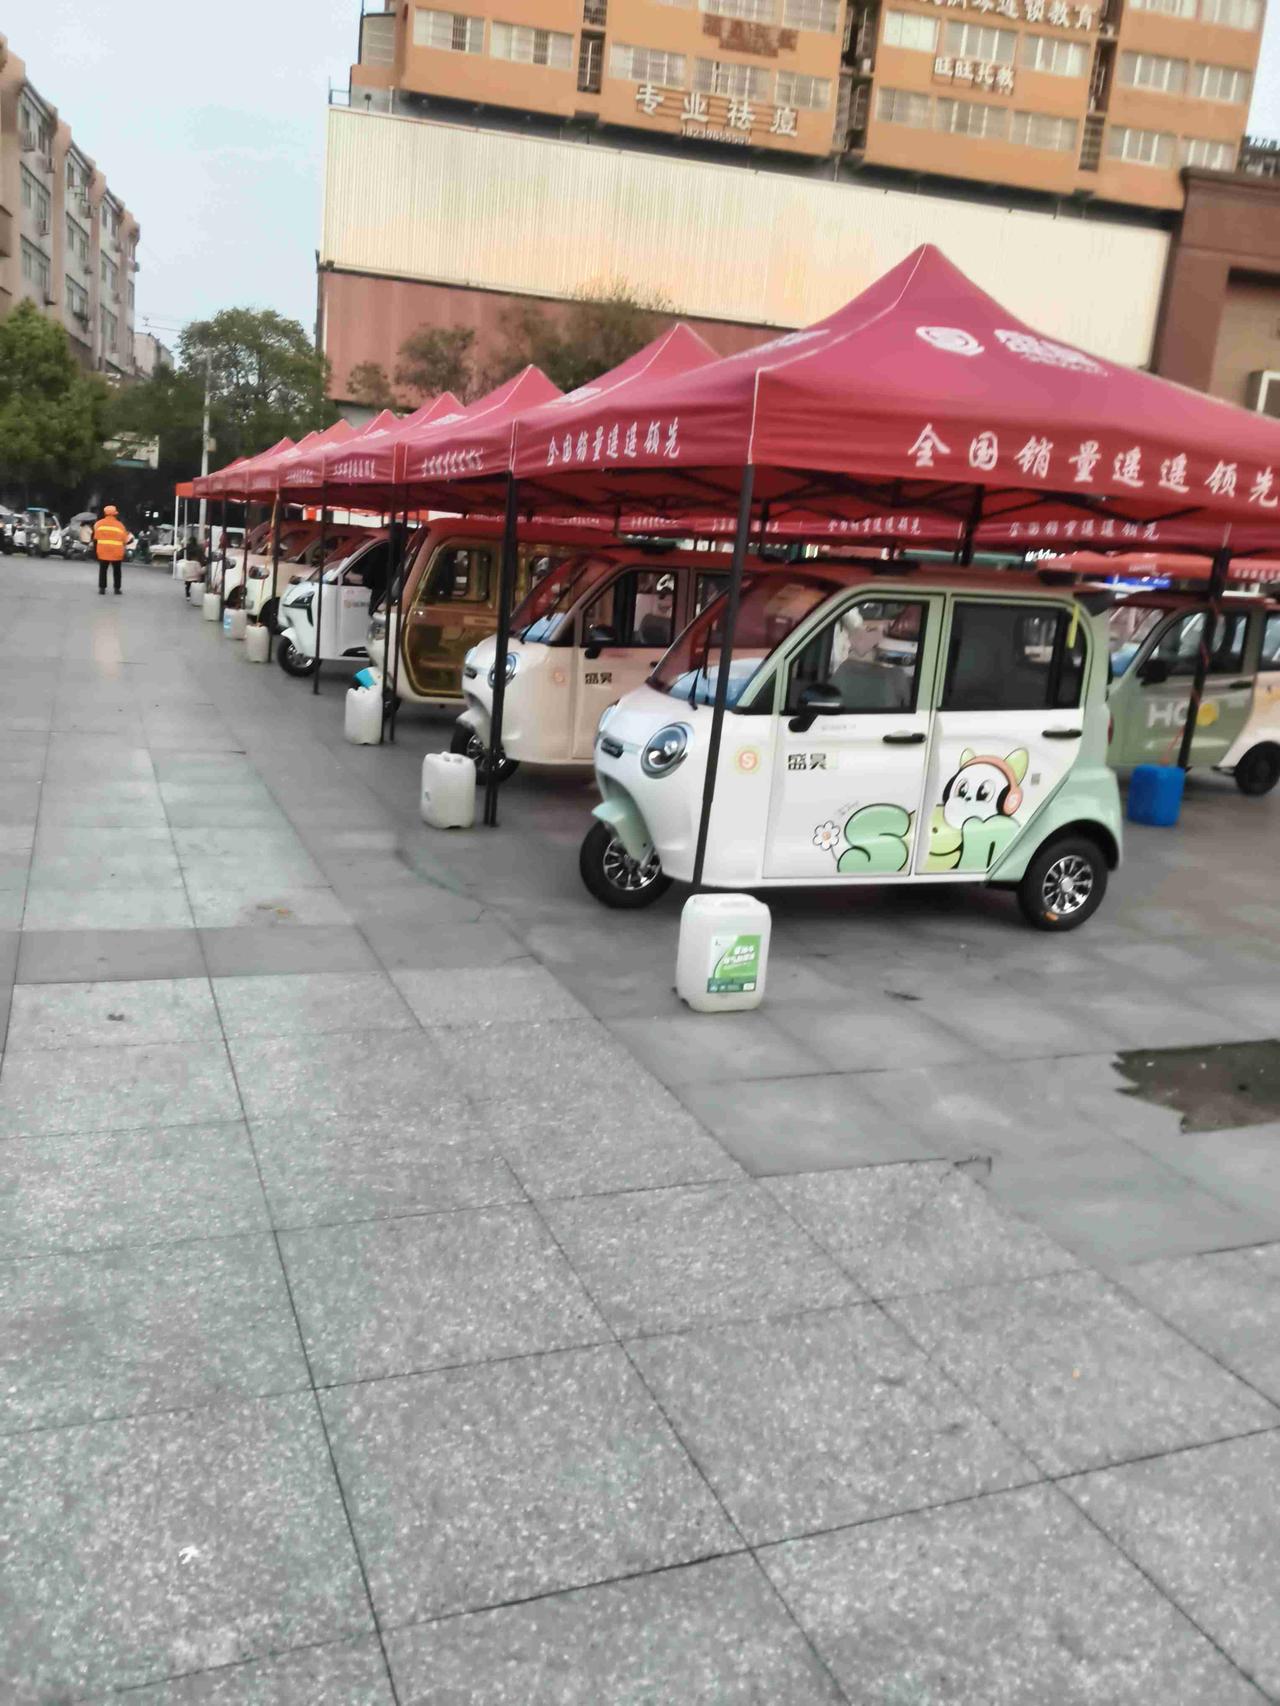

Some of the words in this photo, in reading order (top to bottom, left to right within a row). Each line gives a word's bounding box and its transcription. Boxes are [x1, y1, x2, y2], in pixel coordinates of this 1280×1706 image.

[546, 416, 681, 467] 全国销量遥遥领先
[908, 423, 1279, 508] 全国销量遥遥领先
